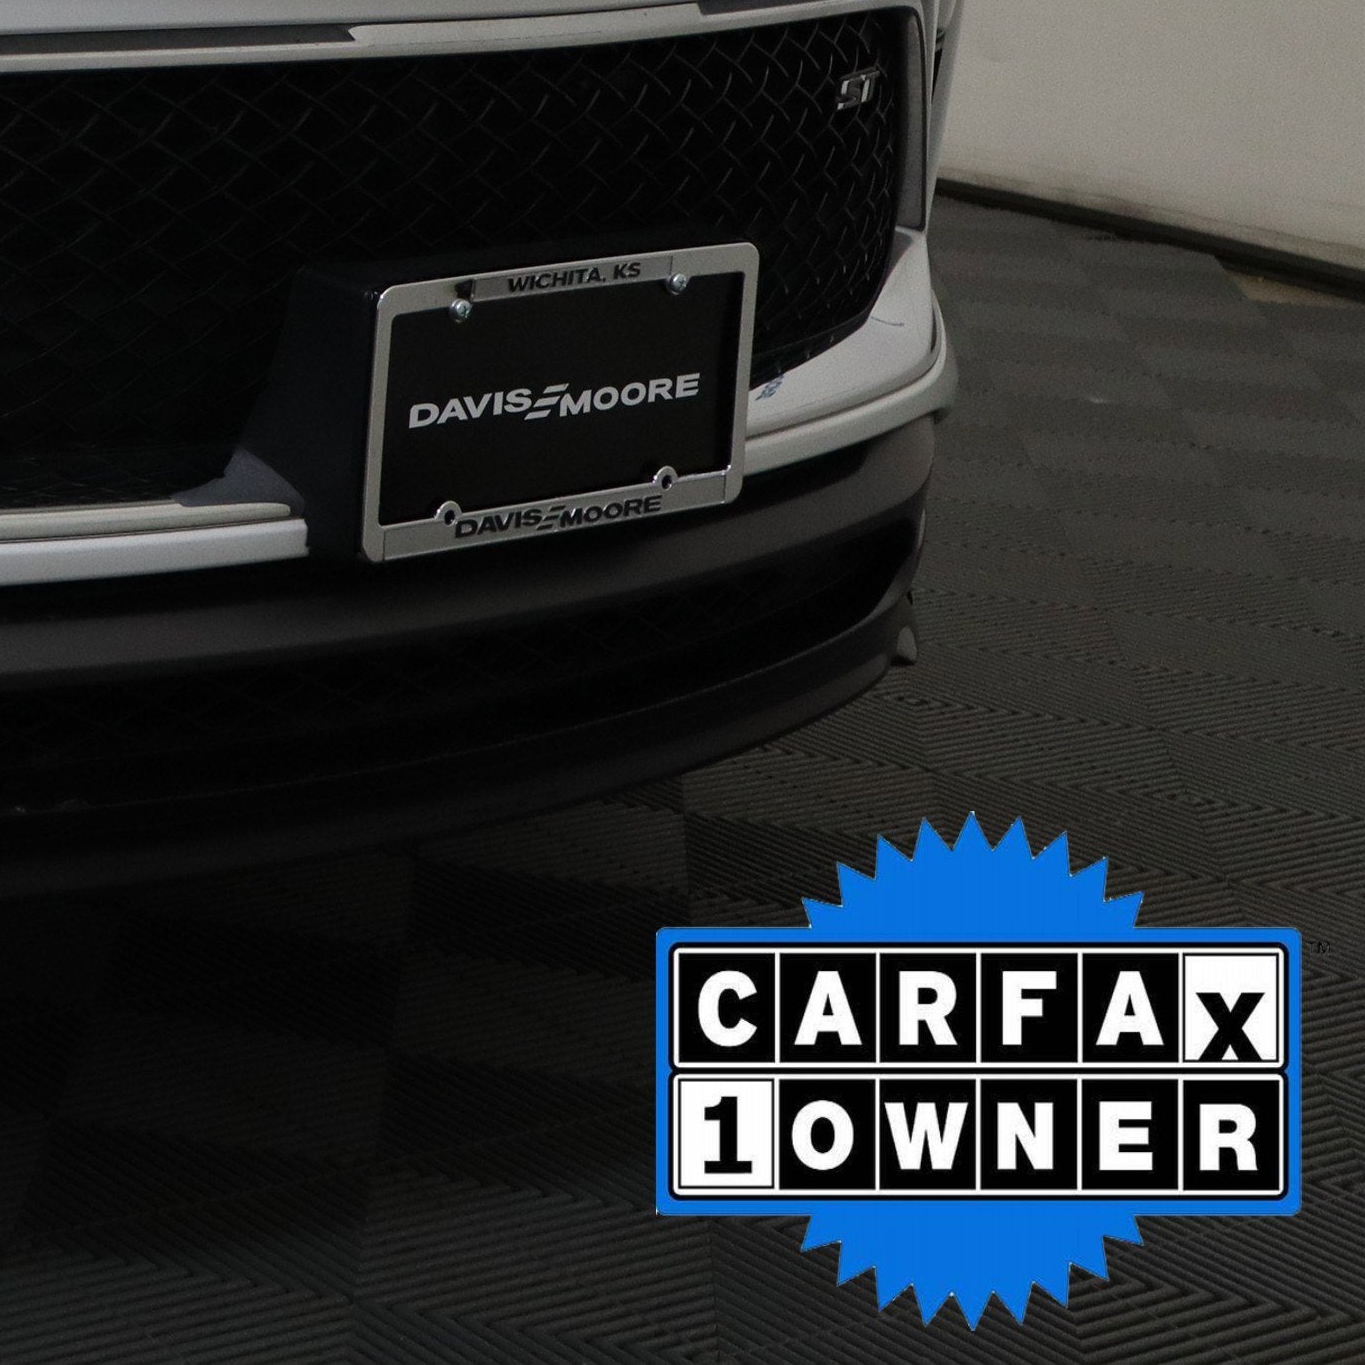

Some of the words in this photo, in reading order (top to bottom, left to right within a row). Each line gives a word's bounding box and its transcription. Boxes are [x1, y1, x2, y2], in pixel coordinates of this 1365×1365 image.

[613, 262, 642, 280] KS
[408, 387, 535, 429] DAVIS
[558, 373, 701, 418] MOORE
[454, 509, 544, 539] DAVIS
[558, 495, 663, 529] MOORE
